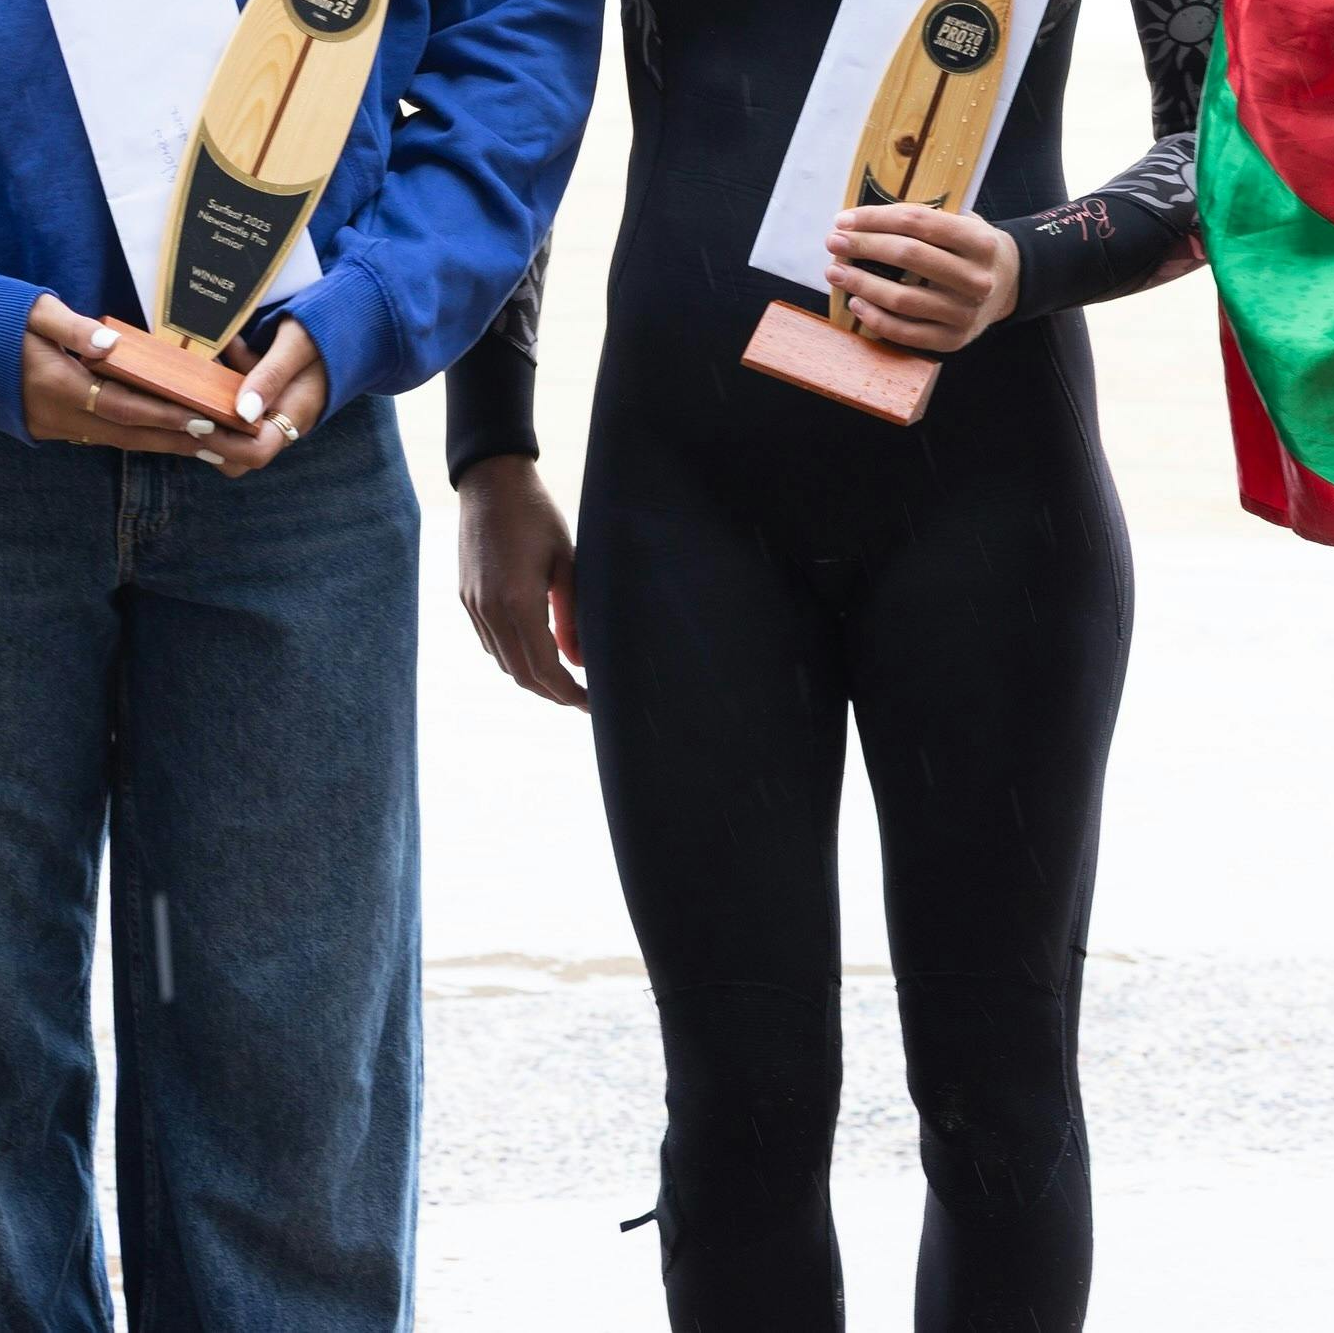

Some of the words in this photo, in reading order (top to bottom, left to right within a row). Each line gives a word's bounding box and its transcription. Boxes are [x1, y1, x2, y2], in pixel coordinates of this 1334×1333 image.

[937, 23, 968, 44] PRO
[197, 209, 250, 239] Newcastle
[249, 231, 269, 247] Pro
[242, 214, 272, 233] 2025
[210, 230, 245, 251] Junior
[191, 265, 237, 293] WINNER
[189, 279, 229, 304] Women
